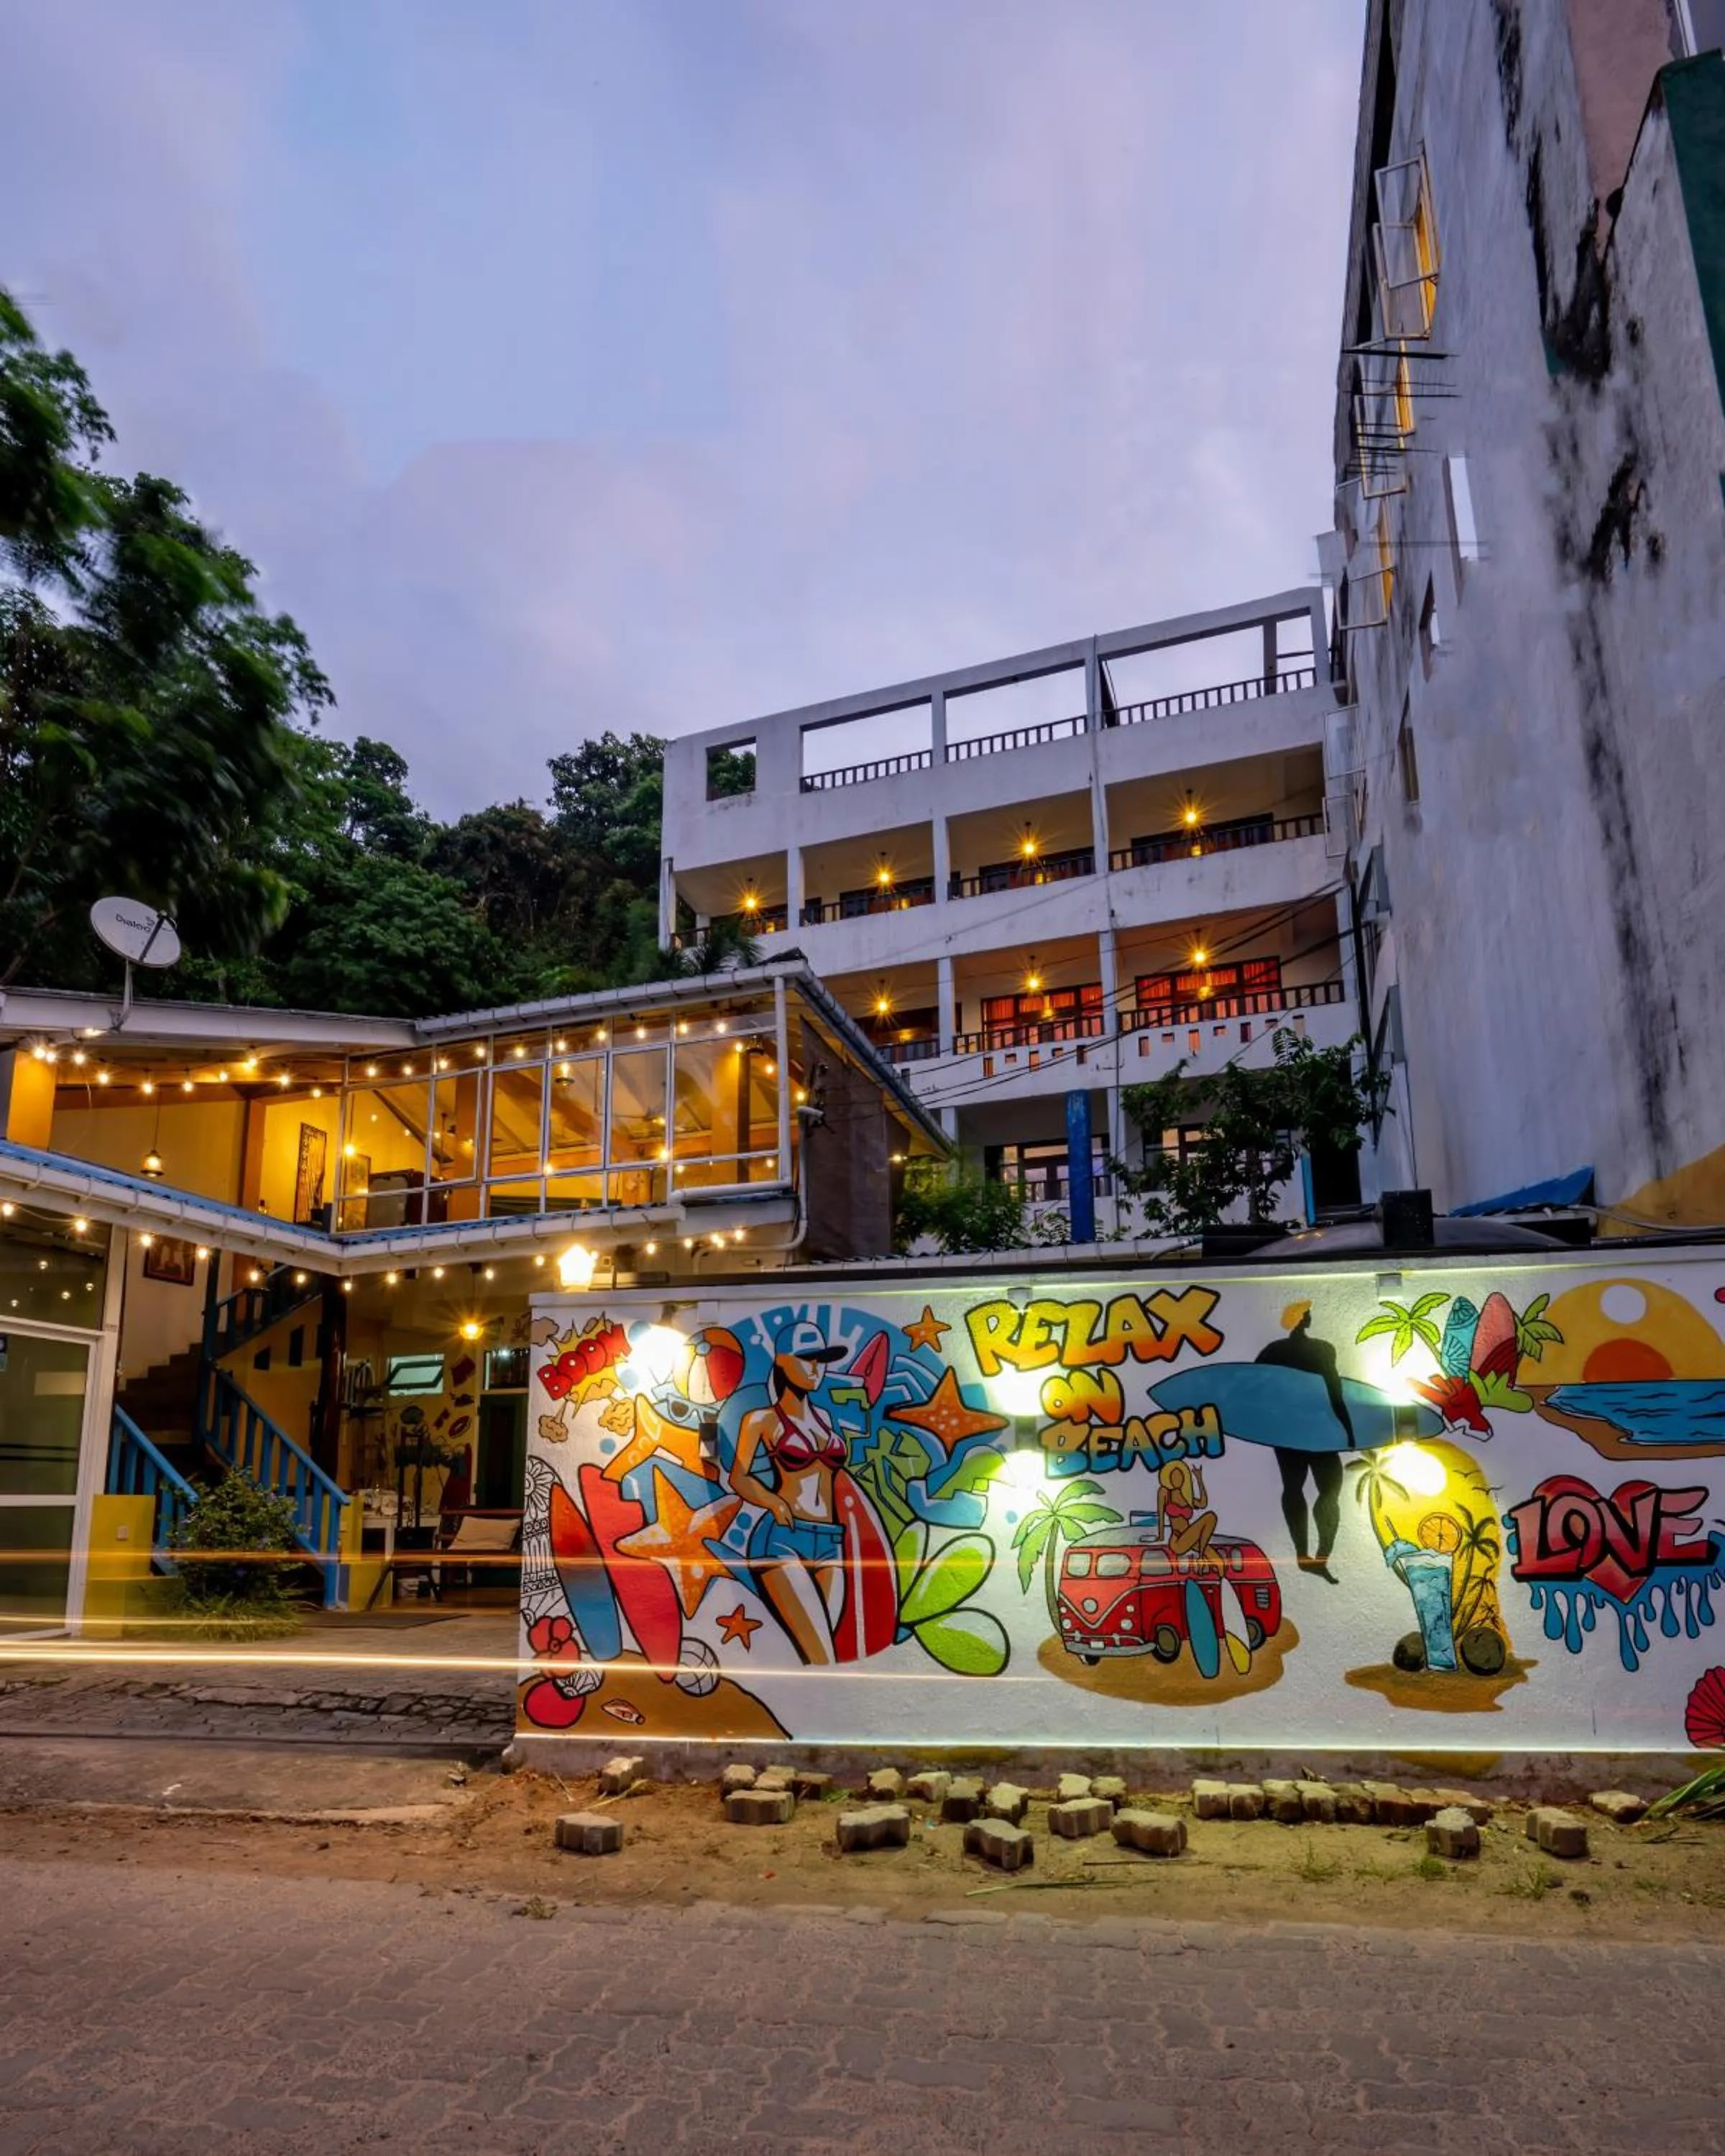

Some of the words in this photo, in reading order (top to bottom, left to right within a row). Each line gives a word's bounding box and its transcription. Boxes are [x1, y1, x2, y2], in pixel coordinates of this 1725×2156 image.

[537, 1324, 632, 1400] BOOM
[965, 1286, 1224, 1377] RELAX
[1040, 1368, 1125, 1425] ON
[1039, 1403, 1225, 1479] BEACH
[1508, 1486, 1719, 1583] LOVE
